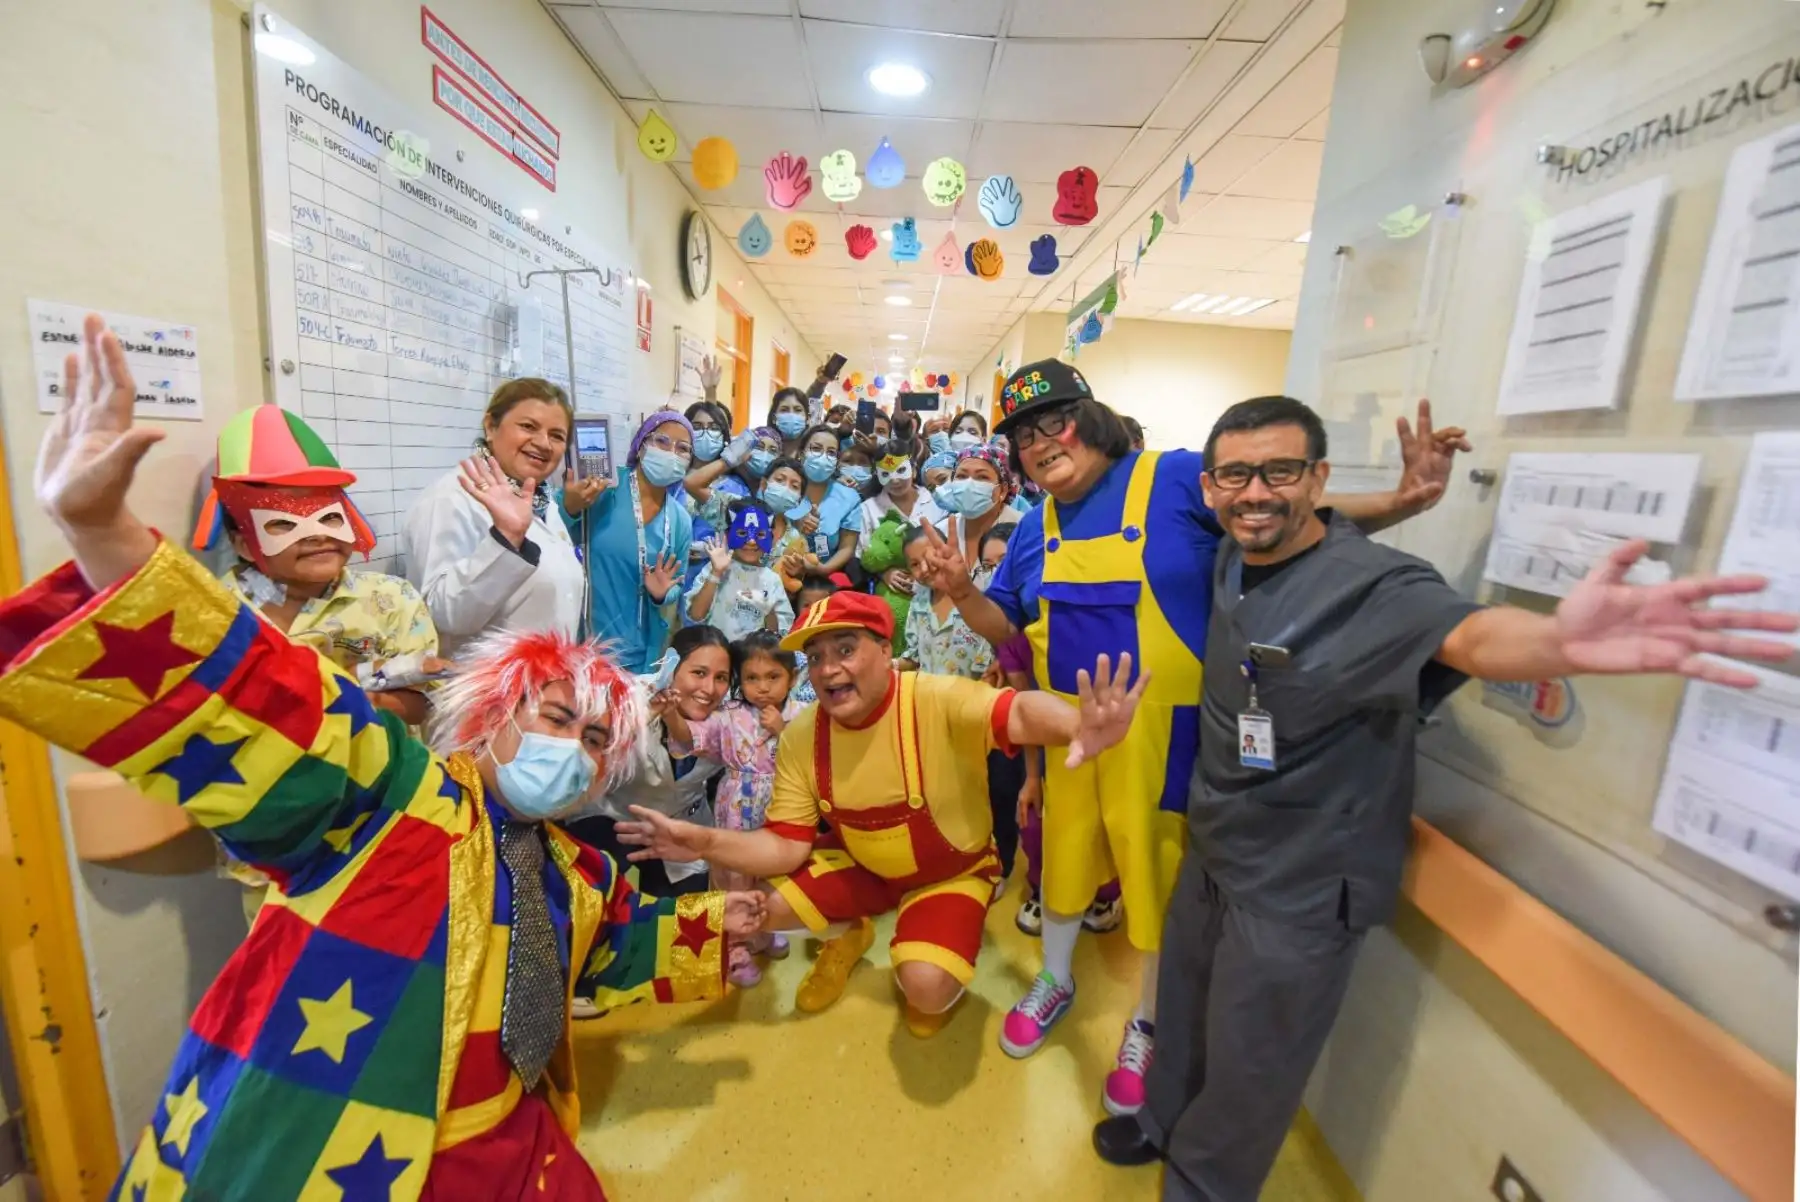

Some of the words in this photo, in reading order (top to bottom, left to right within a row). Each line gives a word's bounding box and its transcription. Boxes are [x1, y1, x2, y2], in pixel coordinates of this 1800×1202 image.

[285, 68, 406, 159] PROGRAMACIÓN
[408, 146, 423, 169] DE
[425, 157, 503, 217] INTERVENCIONES
[323, 136, 378, 174] ESPECIALIDAD
[399, 178, 437, 209] NOMBRES
[438, 201, 443, 210] Y
[1003, 370, 1042, 398] SUPER
[1004, 380, 1051, 416] MARIO
